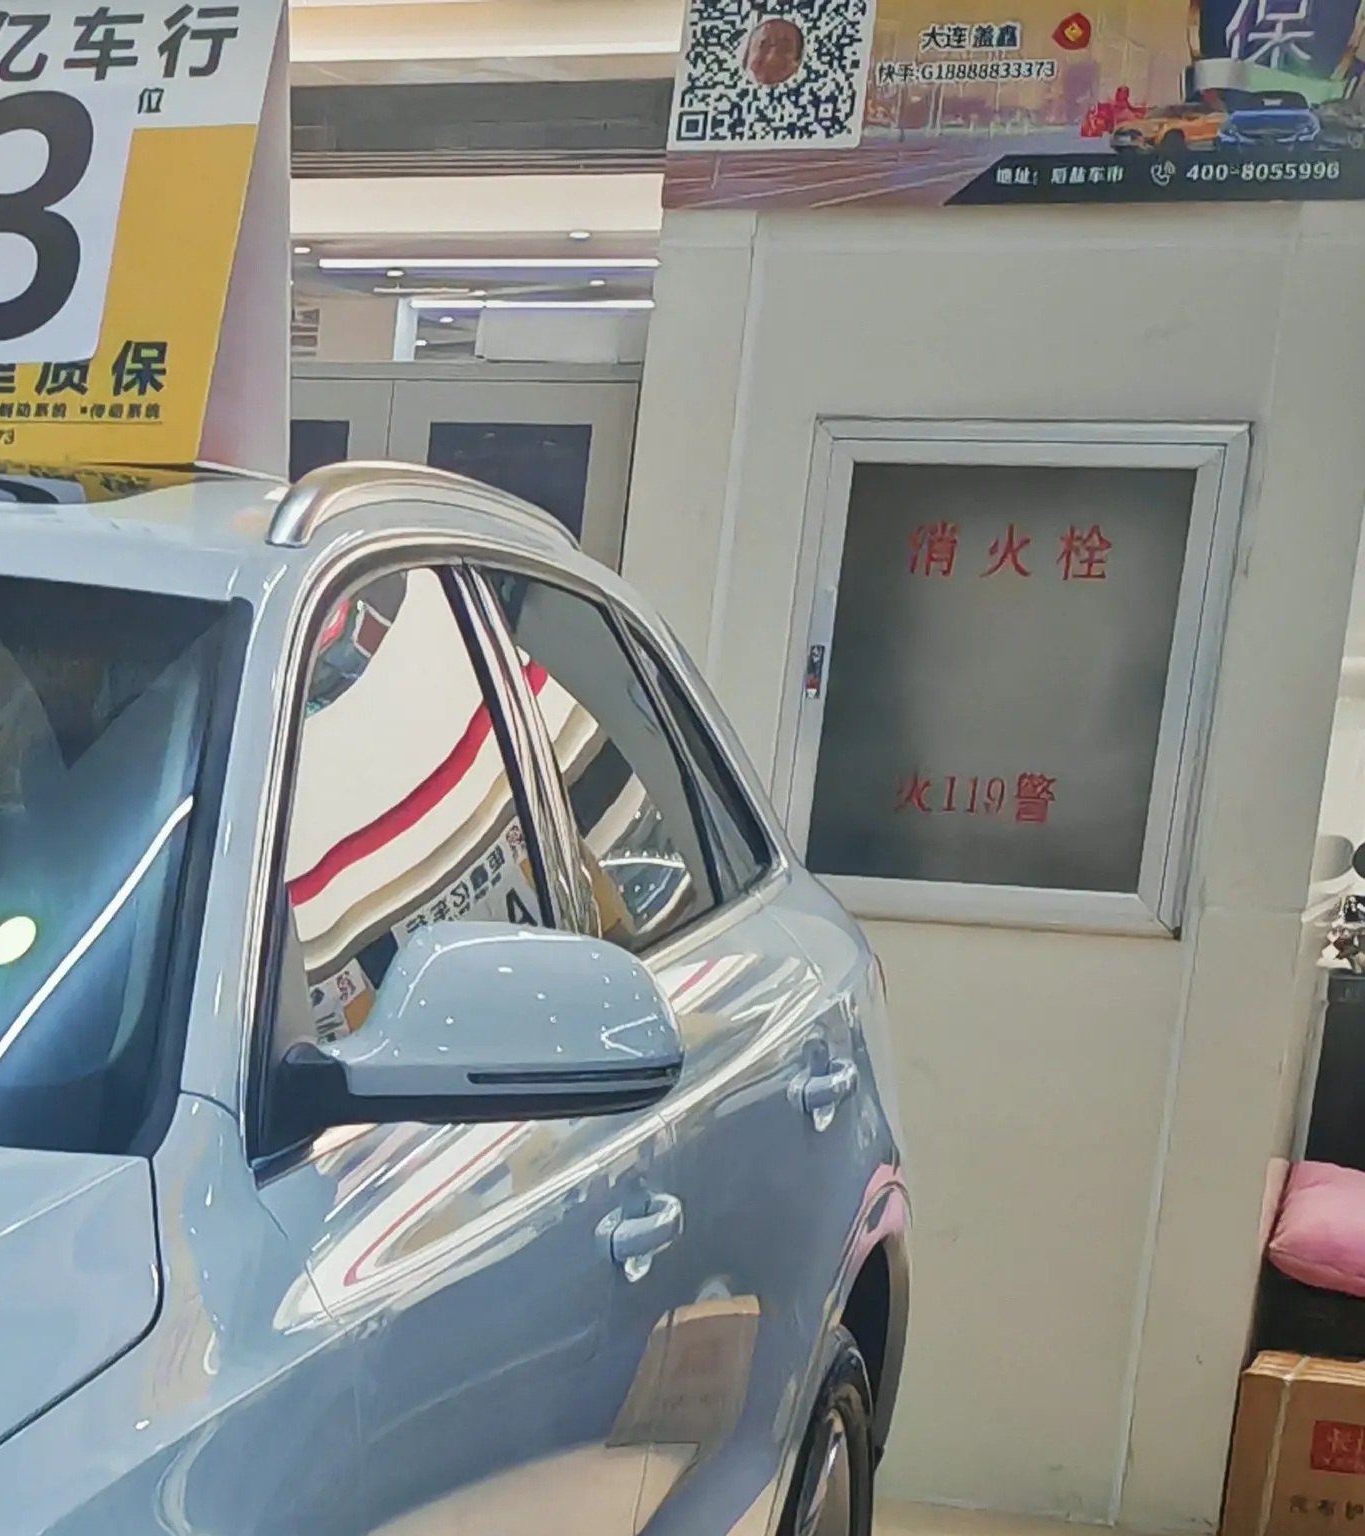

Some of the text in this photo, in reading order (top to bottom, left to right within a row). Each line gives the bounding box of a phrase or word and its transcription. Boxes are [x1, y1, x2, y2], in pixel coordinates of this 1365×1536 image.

[907, 519, 1113, 580] 消火栓
[893, 767, 1058, 824] 火119警
